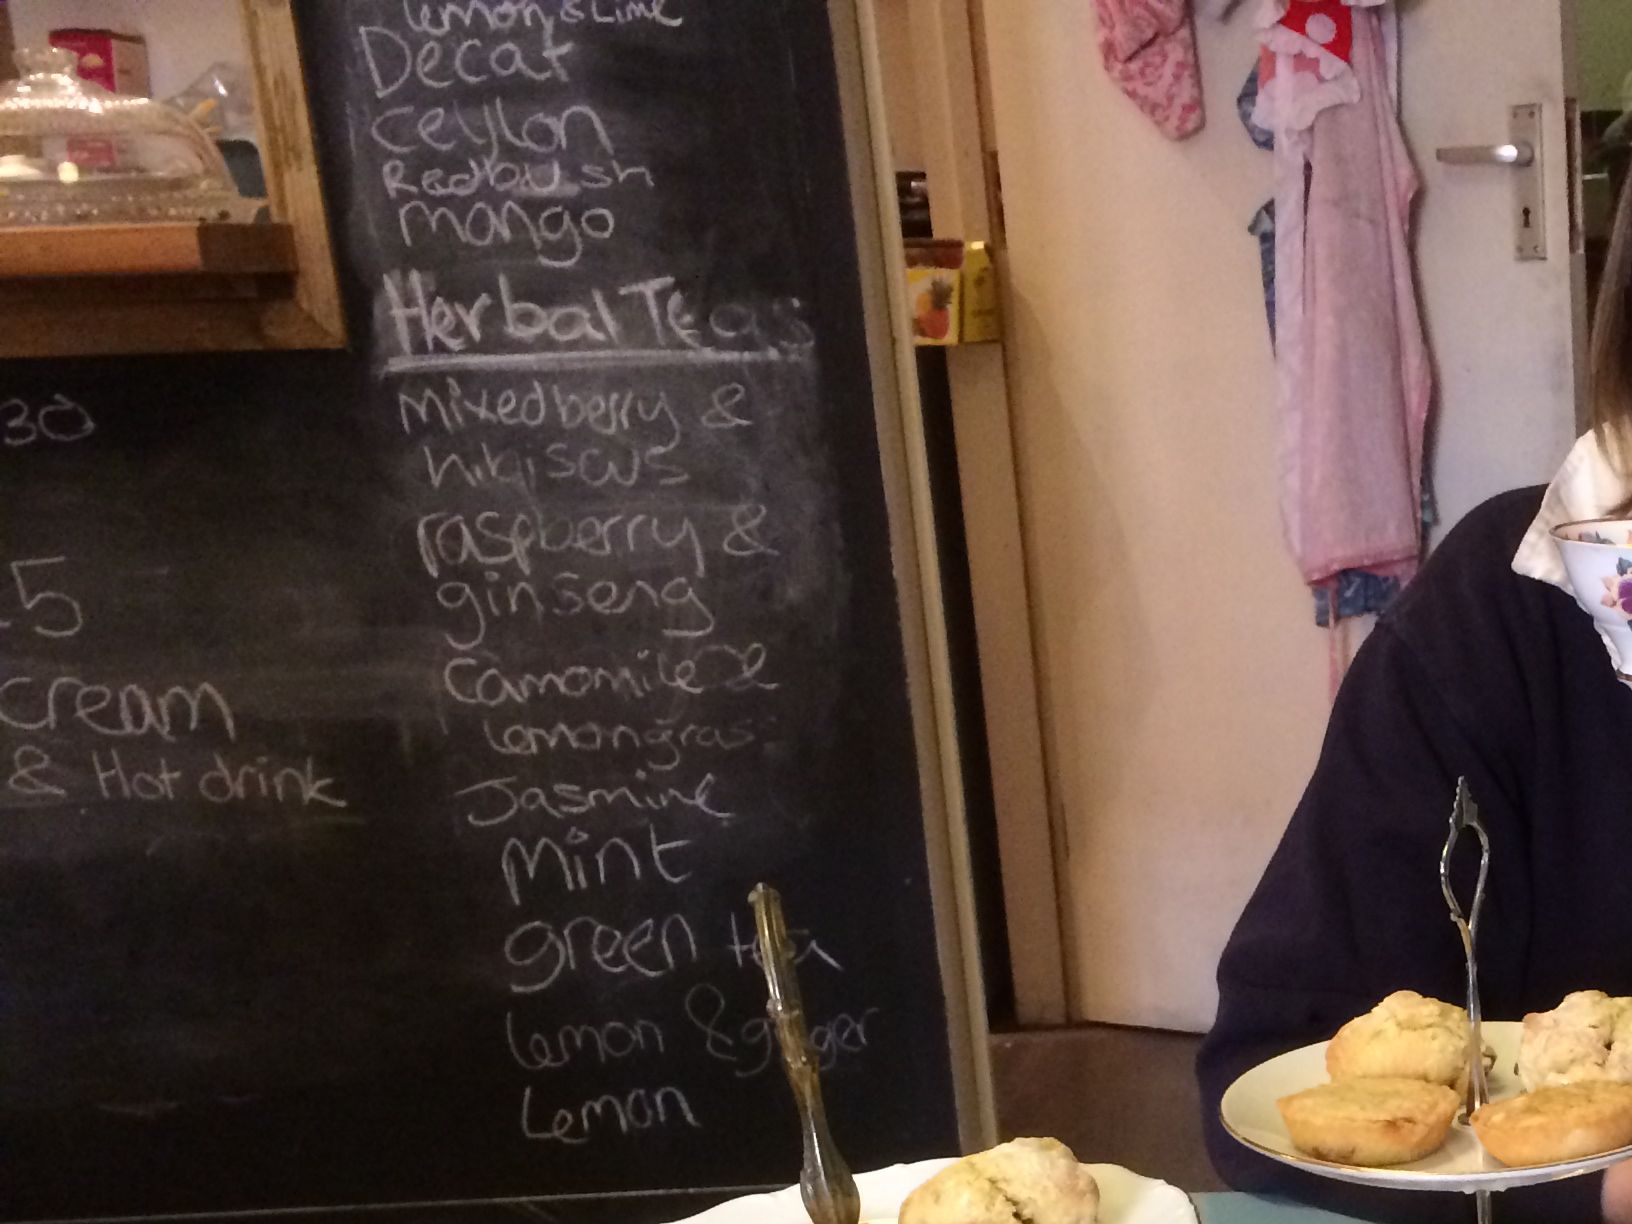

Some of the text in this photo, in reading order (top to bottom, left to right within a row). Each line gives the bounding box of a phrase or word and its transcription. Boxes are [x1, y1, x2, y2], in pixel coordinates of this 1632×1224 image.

[359, 22, 575, 98] Decaf
[382, 268, 618, 355] Herbal
[702, 382, 754, 428] &
[723, 504, 780, 556] &
[437, 571, 716, 650] ginseng
[7, 744, 348, 808] & Hot drink
[454, 768, 735, 826] Jasmine
[504, 914, 698, 993] green
[686, 983, 738, 1060] &
[735, 1008, 880, 1078] gger
